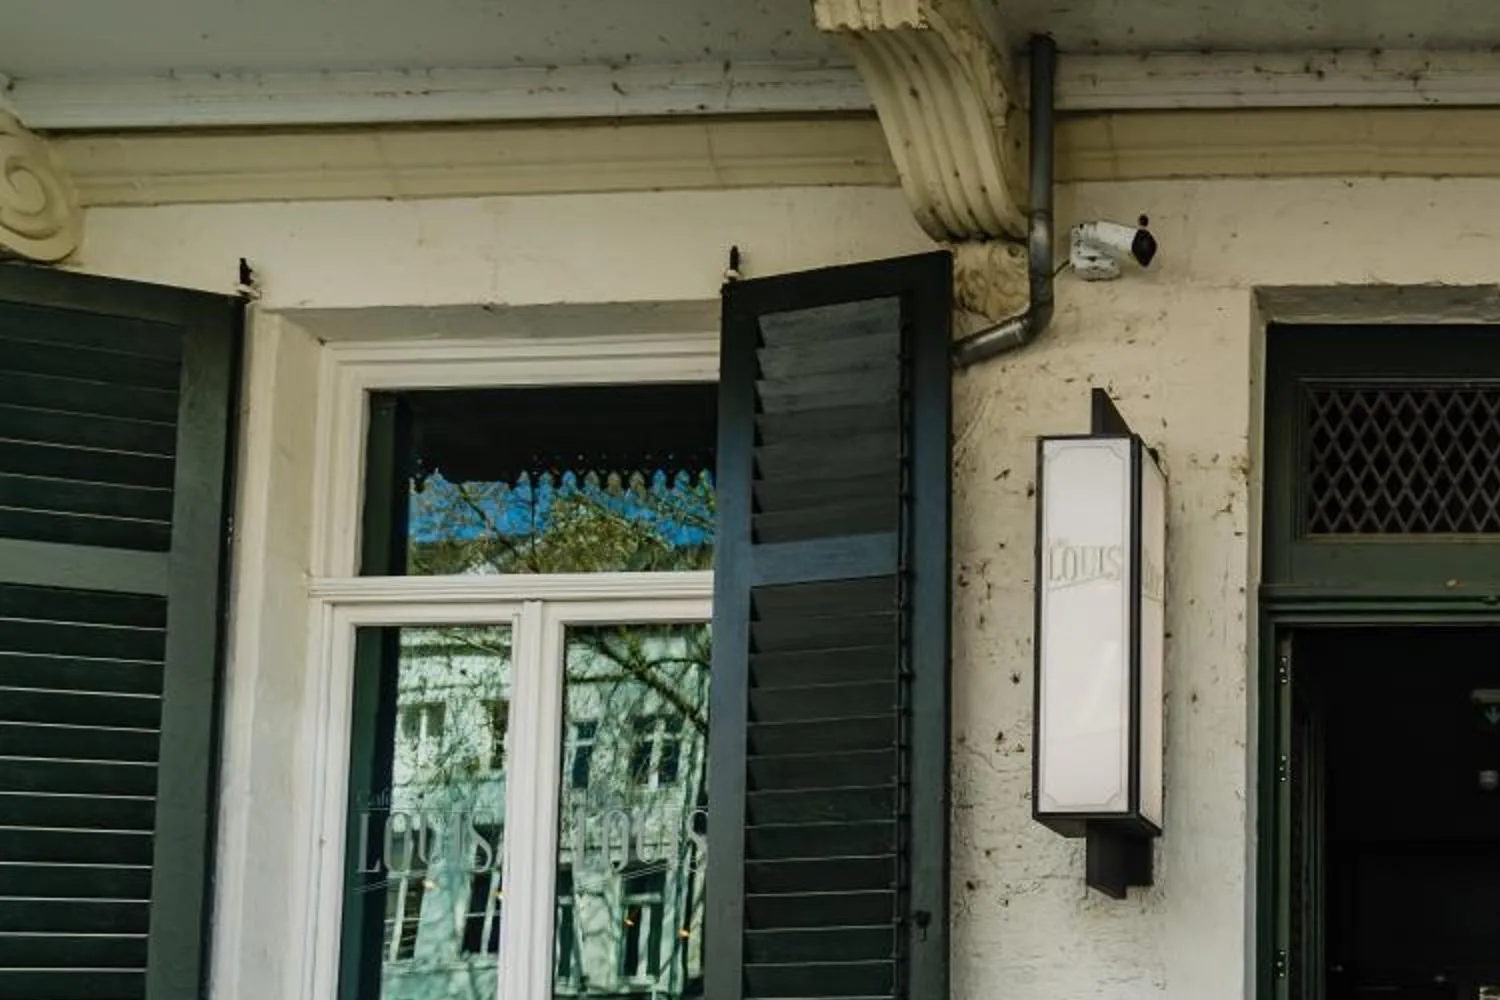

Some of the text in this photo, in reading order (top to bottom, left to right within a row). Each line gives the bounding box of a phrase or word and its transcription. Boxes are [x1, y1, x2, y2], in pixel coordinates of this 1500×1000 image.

[1047, 543, 1121, 581] LOUIS
[358, 811, 493, 873] LOUIS
[574, 808, 708, 873] LOUIS
